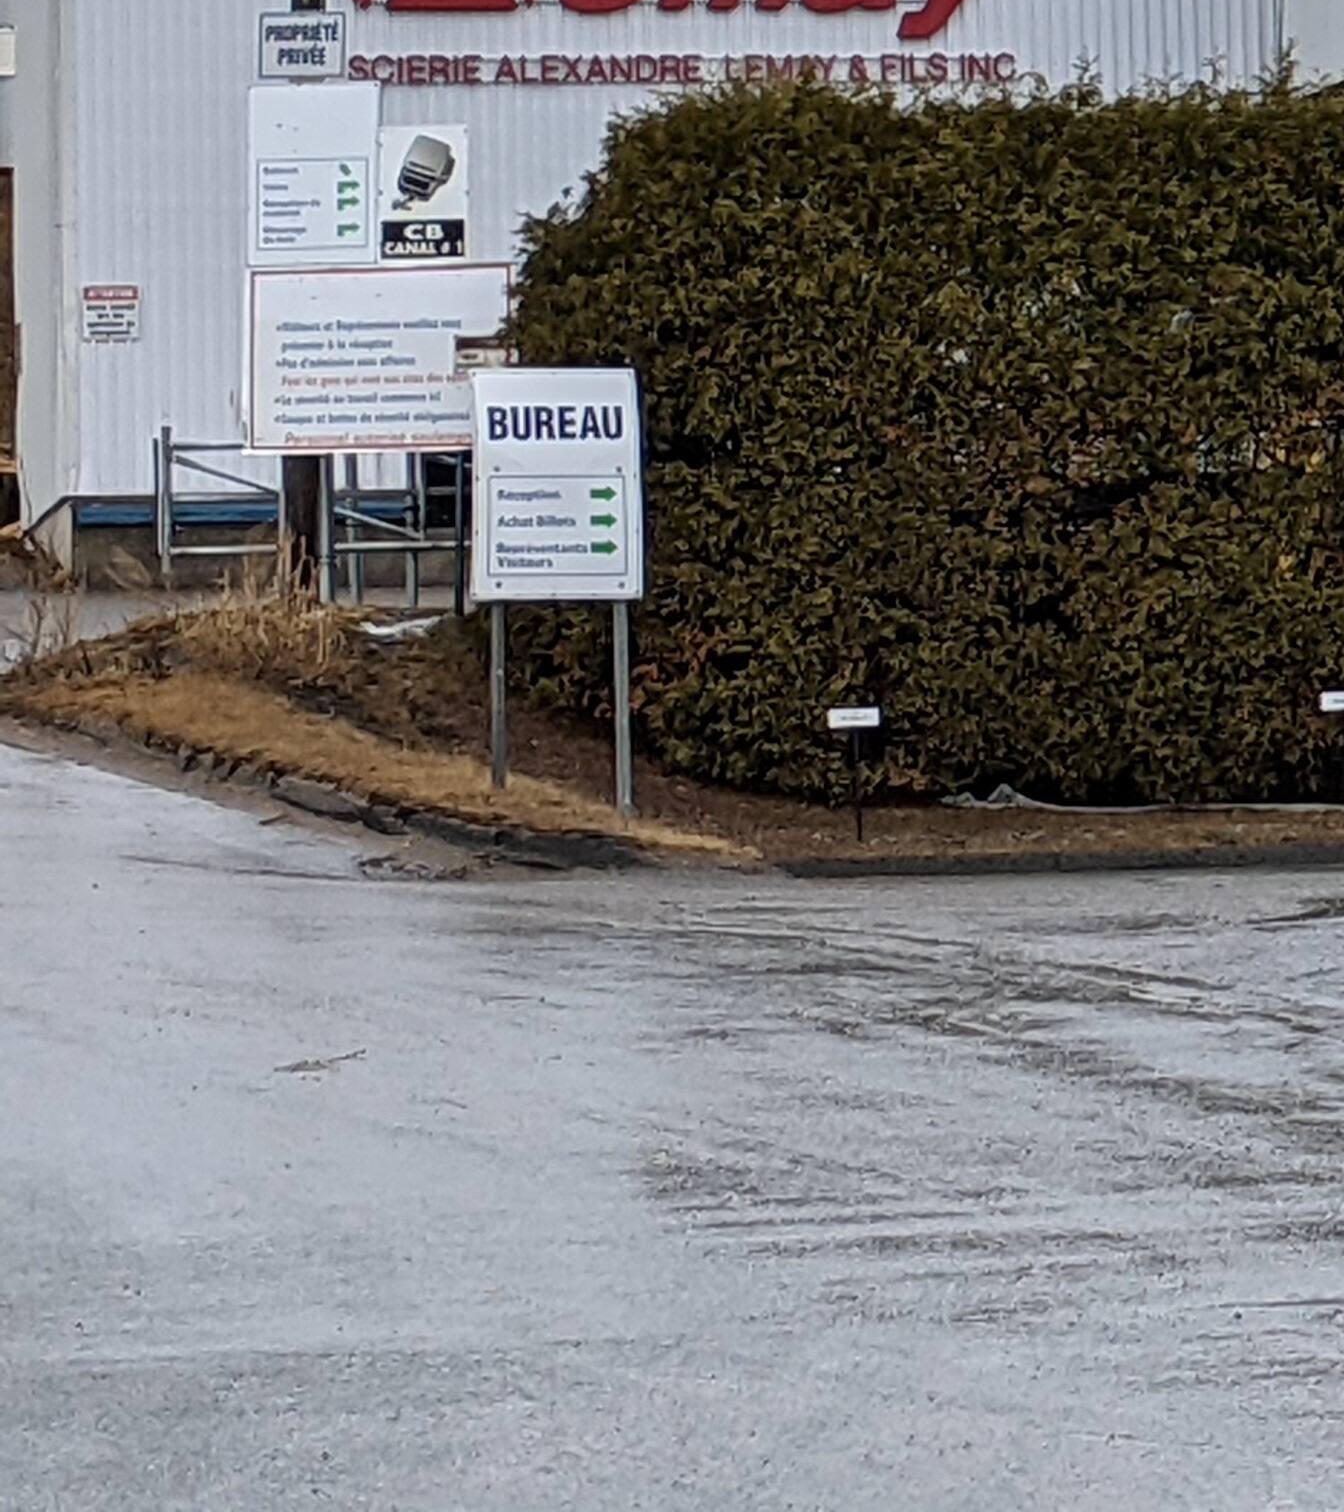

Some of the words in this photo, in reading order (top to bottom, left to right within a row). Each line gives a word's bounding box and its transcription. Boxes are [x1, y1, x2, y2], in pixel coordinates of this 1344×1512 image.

[277, 43, 327, 66] PRIVÉE
[349, 55, 481, 83] SCIERIE
[496, 55, 701, 84] ALEXANDRE
[849, 54, 870, 82] &
[880, 52, 948, 85] FILS
[403, 224, 444, 240] CB
[384, 242, 438, 254] CANAL
[487, 406, 623, 440] BUREAU
